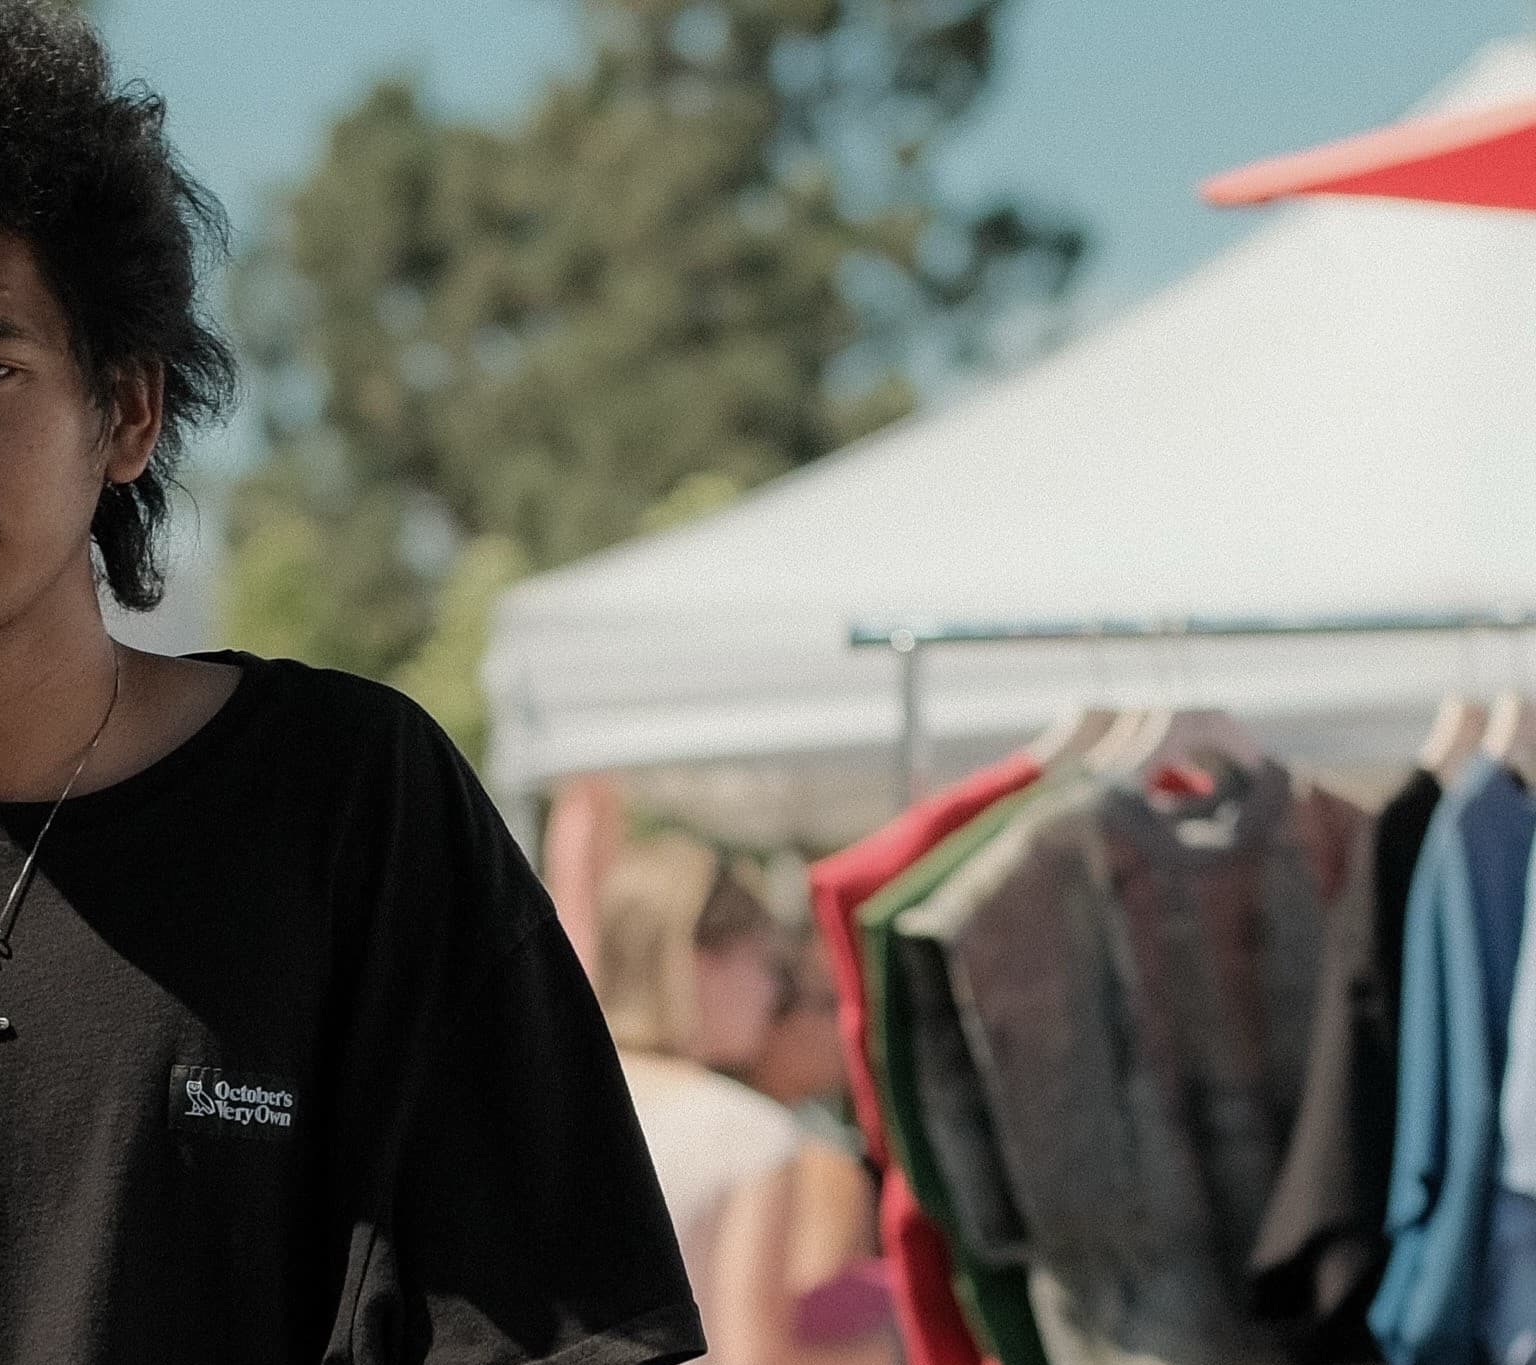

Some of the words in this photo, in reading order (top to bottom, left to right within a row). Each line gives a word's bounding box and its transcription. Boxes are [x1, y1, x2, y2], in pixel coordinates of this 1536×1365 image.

[214, 1080, 293, 1107] October's
[214, 1100, 255, 1125] Very
[254, 1104, 291, 1126] Own
